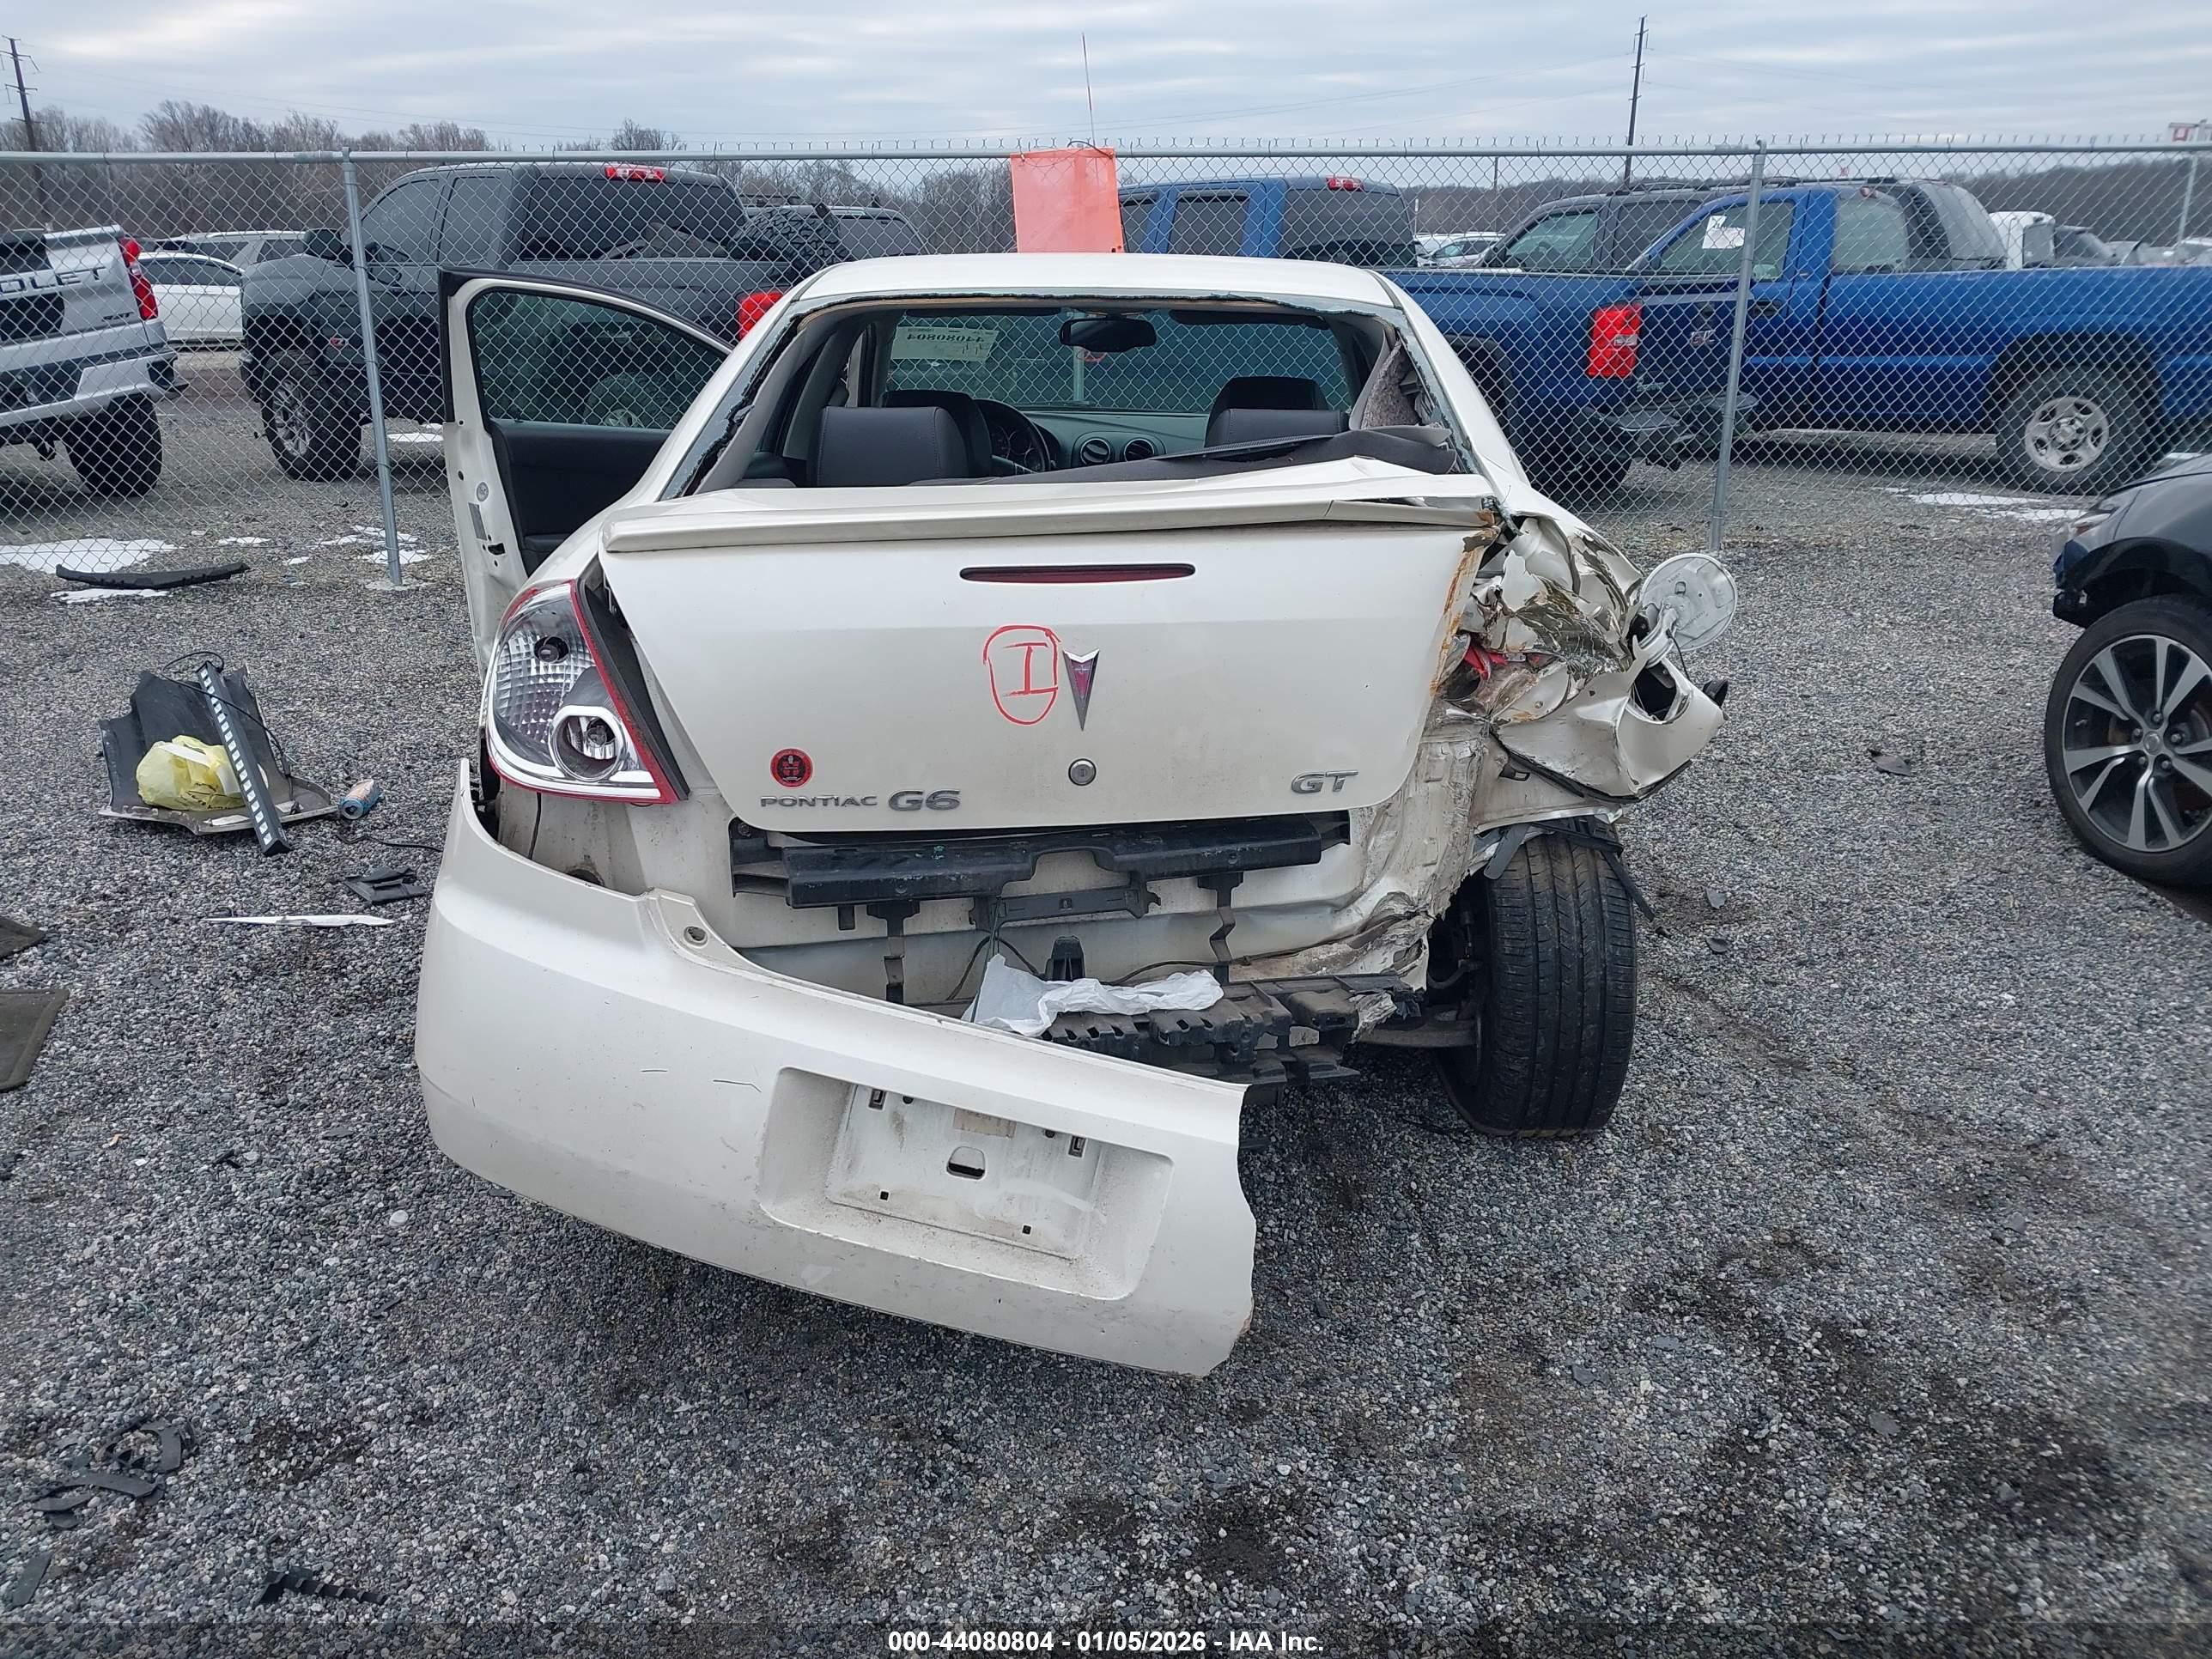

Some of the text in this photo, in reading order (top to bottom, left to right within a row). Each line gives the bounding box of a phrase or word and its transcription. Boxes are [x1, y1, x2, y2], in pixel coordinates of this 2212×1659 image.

[1291, 769, 1359, 794] GT
[760, 788, 962, 811] PONTIAC G6
